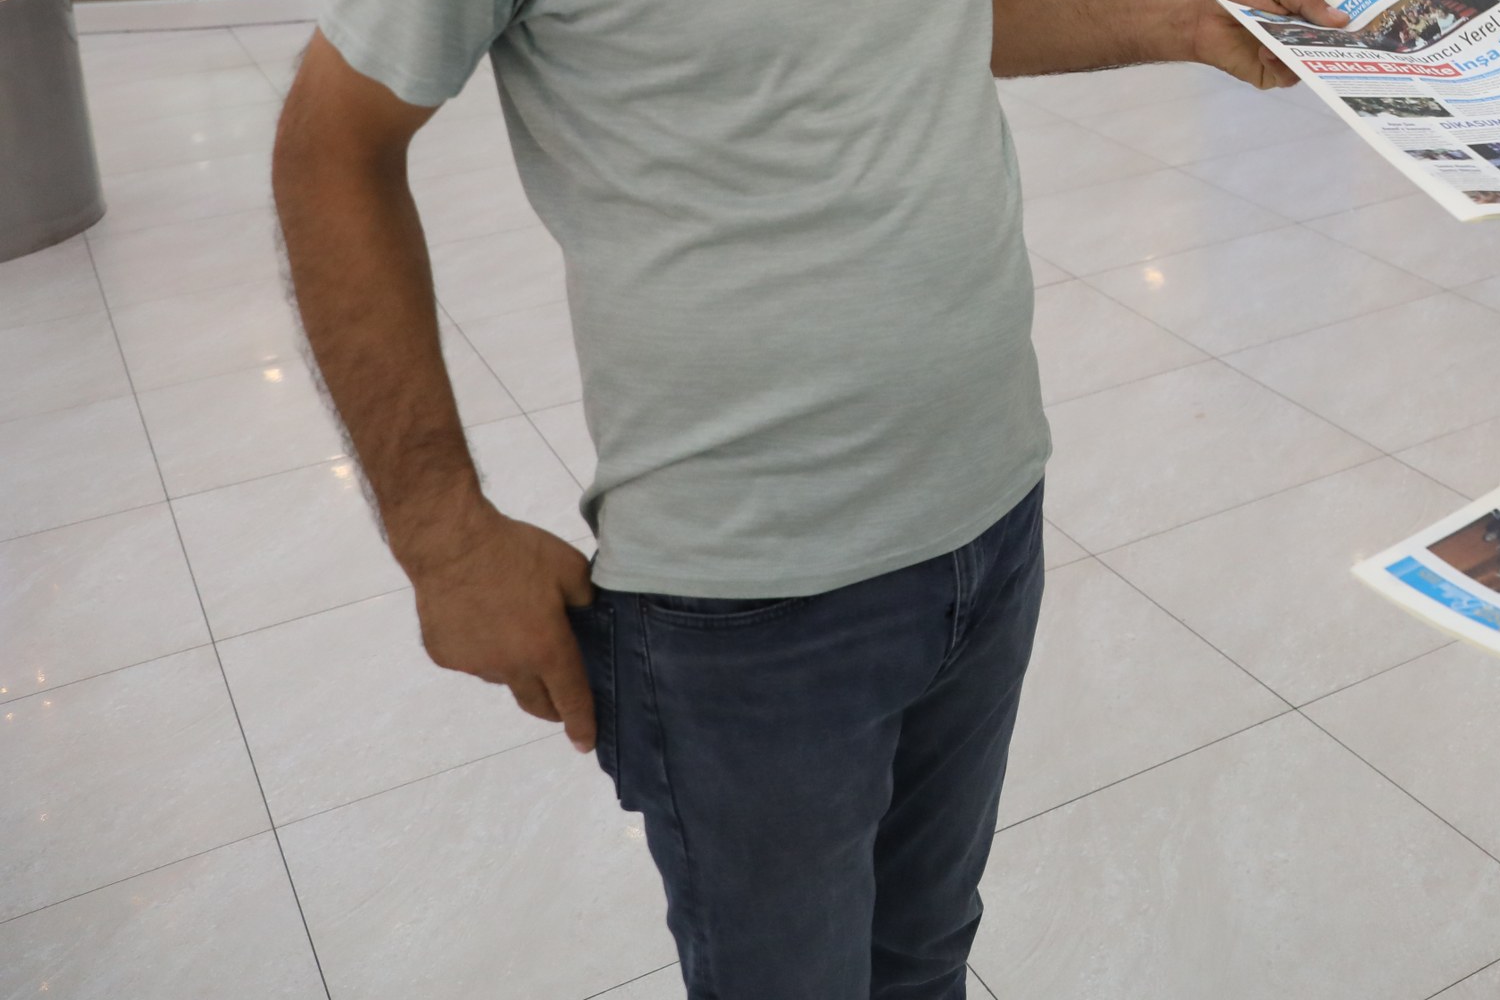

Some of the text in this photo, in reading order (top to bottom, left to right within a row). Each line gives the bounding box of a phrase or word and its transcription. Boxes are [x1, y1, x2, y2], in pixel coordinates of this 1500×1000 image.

[1290, 46, 1382, 60] Demokratik
[1307, 61, 1375, 74] Halkla
[1378, 62, 1453, 76] Birlikte
